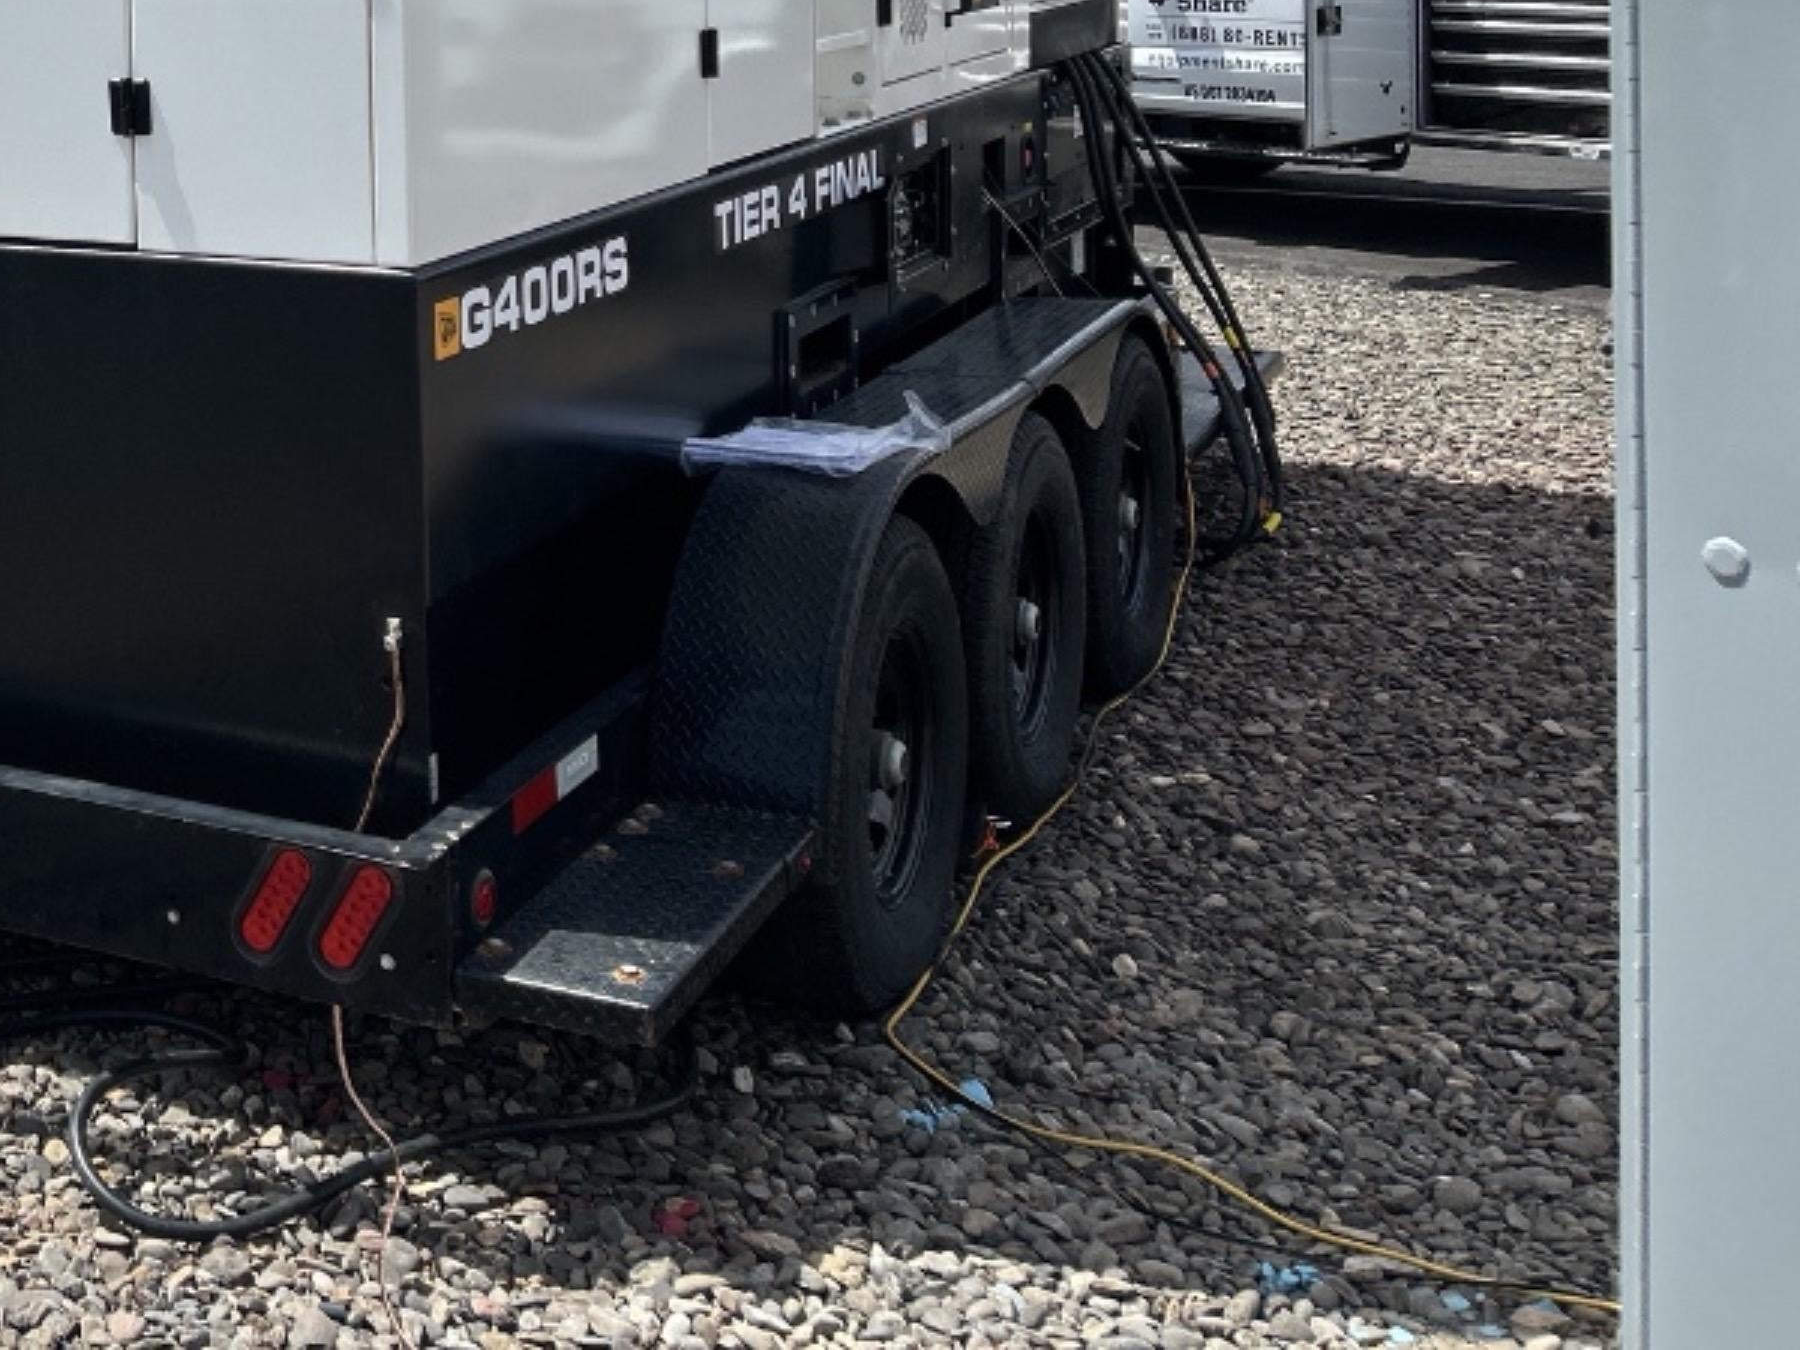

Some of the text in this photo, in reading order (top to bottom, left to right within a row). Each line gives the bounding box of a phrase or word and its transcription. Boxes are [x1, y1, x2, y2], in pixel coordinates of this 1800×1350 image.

[715, 149, 886, 250] TIER 4 FINAL
[461, 236, 629, 350] G400RS
